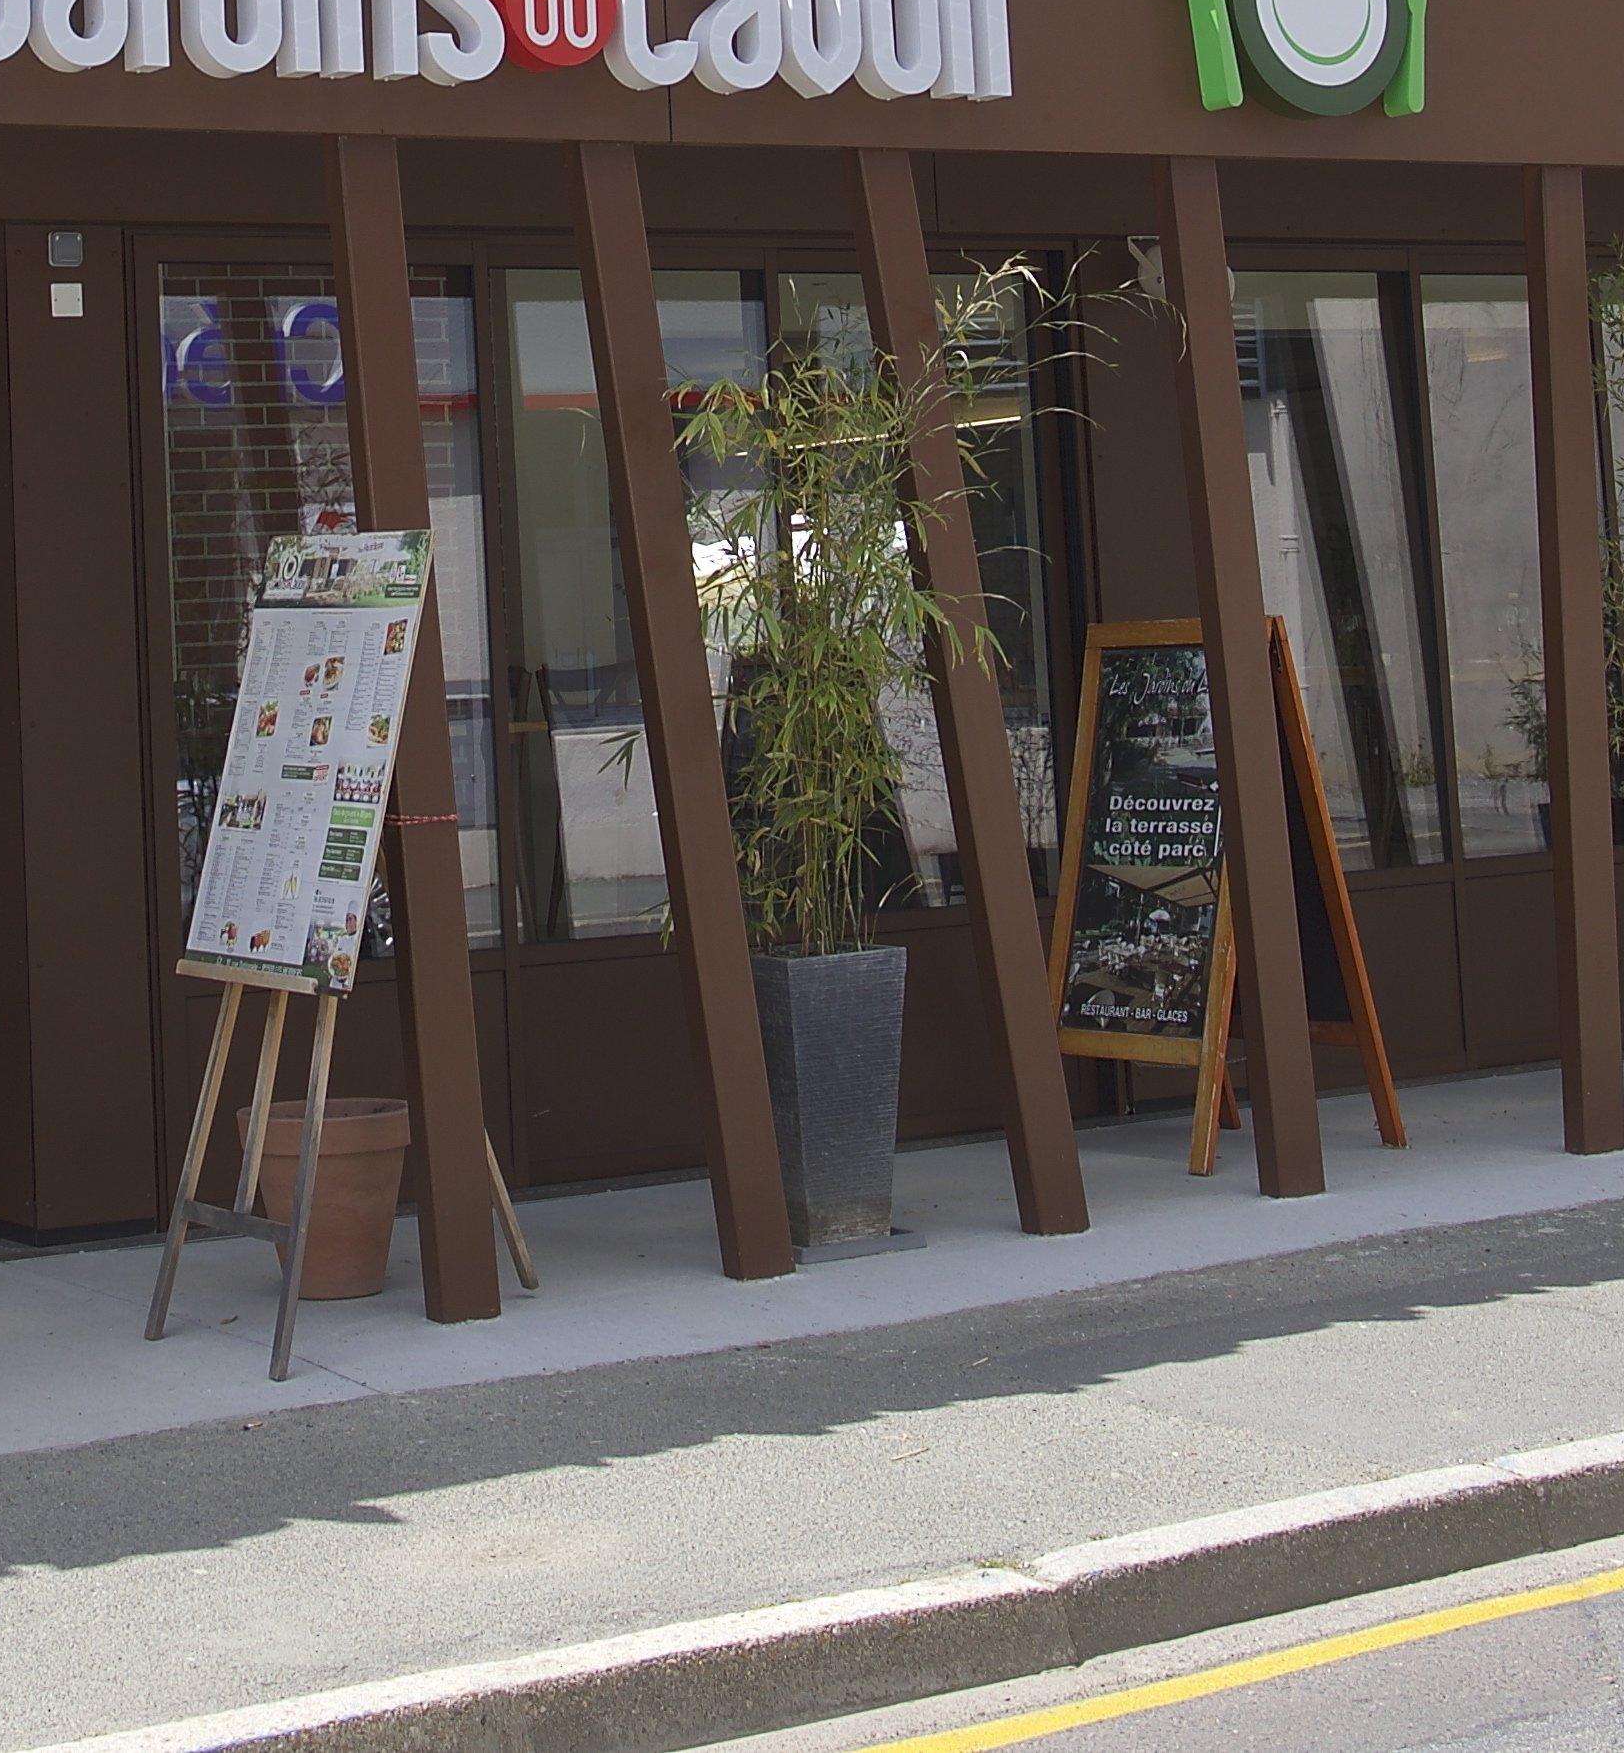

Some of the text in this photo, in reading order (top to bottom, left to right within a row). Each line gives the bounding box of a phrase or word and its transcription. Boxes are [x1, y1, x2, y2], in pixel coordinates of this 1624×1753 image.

[1109, 673, 1131, 696] Les
[1109, 795, 1215, 811] Découvrez
[1105, 817, 1122, 833] la
[1109, 839, 1204, 860] côté parc
[1080, 1003, 1130, 1018] RESTAURANT
[1135, 1007, 1152, 1020] BAR
[1156, 1009, 1188, 1023] GLACES
